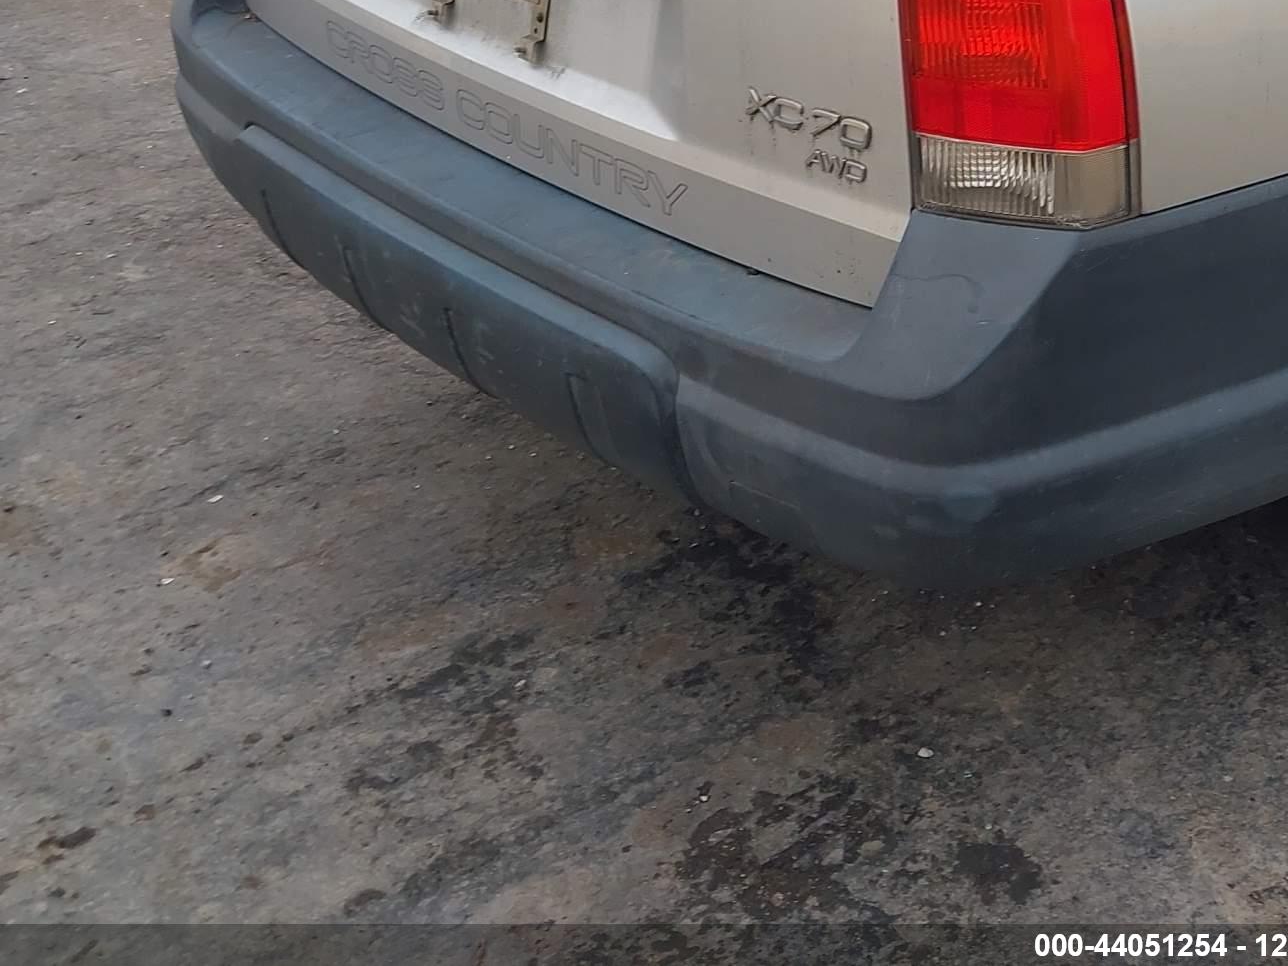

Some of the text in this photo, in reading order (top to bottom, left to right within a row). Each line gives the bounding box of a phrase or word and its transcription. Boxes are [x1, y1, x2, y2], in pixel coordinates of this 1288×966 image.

[326, 20, 688, 216] CROSS COUNTRY
[745, 86, 873, 151] XC70
[806, 149, 868, 184] AWD
